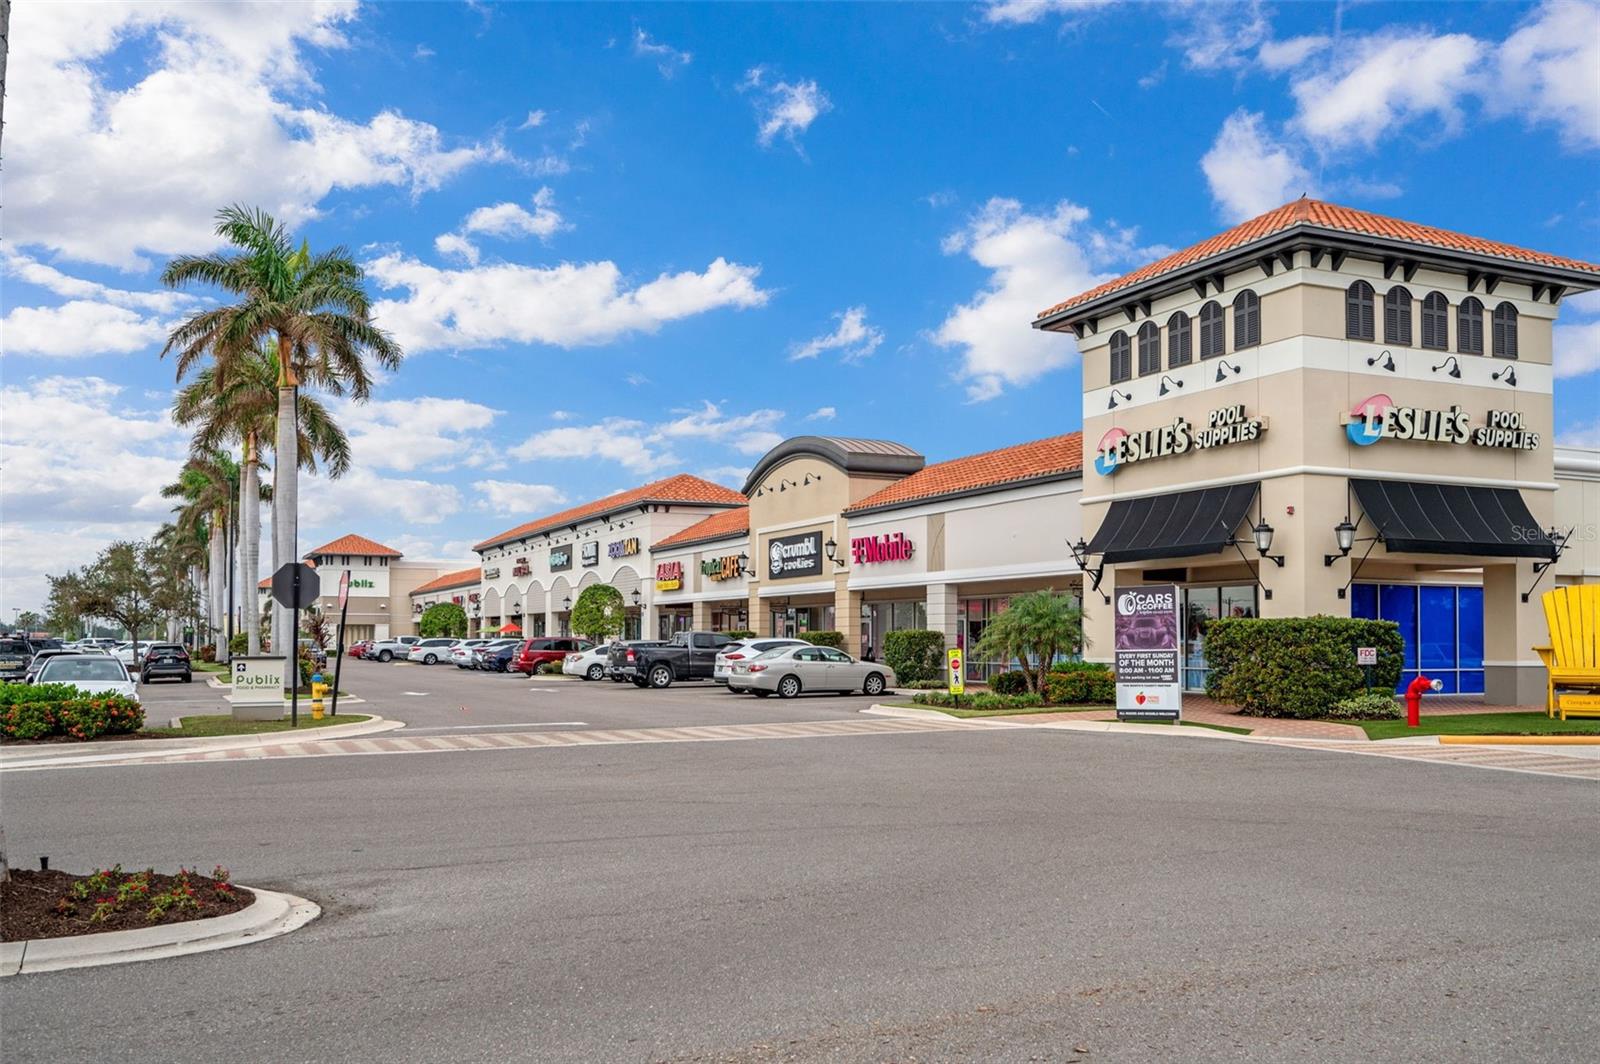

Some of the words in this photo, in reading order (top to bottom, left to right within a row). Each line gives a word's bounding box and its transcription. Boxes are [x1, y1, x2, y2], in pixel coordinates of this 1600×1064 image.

[1208, 404, 1246, 427] POOL
[1363, 404, 1470, 445] LESLIE'S
[1489, 410, 1525, 430] POOL
[1103, 417, 1191, 468] LESLIE'S
[1195, 421, 1260, 449] SUPPLIES
[1476, 428, 1540, 450] SUPPLIES
[783, 558, 815, 571] cookies
[1136, 593, 1173, 604] CARS
[1119, 659, 1129, 667] OF
[1130, 659, 1145, 667] THE
[1146, 659, 1175, 667] MONTH
[1359, 649, 1375, 657] FDC
[235, 674, 280, 685] Publix
